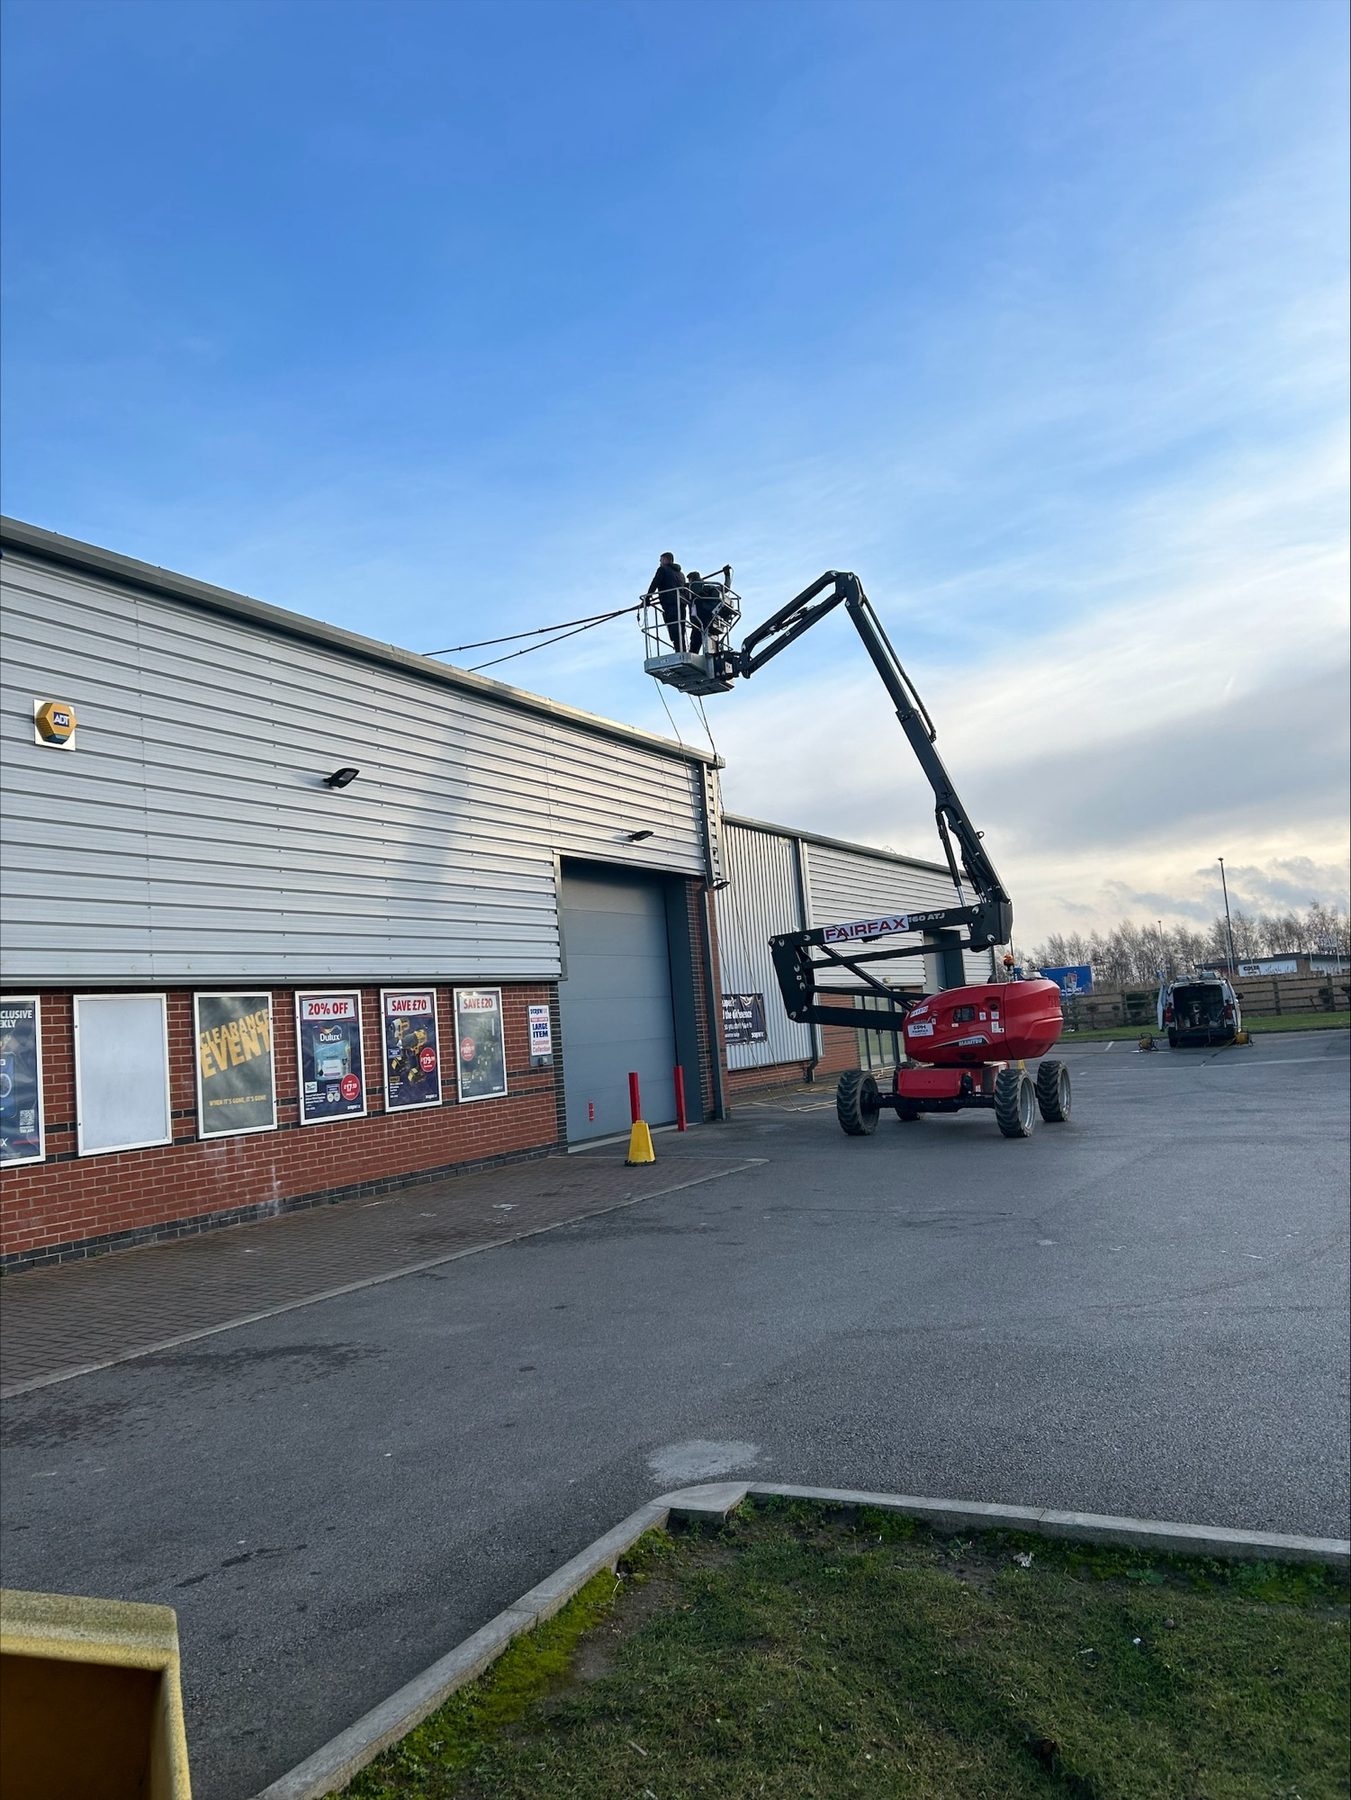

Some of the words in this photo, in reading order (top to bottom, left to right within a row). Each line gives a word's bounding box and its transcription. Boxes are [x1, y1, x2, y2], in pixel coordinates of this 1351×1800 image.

[54, 714, 69, 726] ADT
[825, 918, 906, 941] FAIRFAX
[928, 913, 946, 922] ATJ
[308, 1003, 330, 1015] 20%
[332, 1002, 348, 1014] OFF
[392, 1000, 411, 1011] SAVE
[412, 1000, 427, 1010] £70
[463, 999, 480, 1009] SAVE
[200, 1008, 270, 1049] CLEARANCE
[320, 1033, 342, 1042] Dulux
[200, 1023, 270, 1079] EVENT
